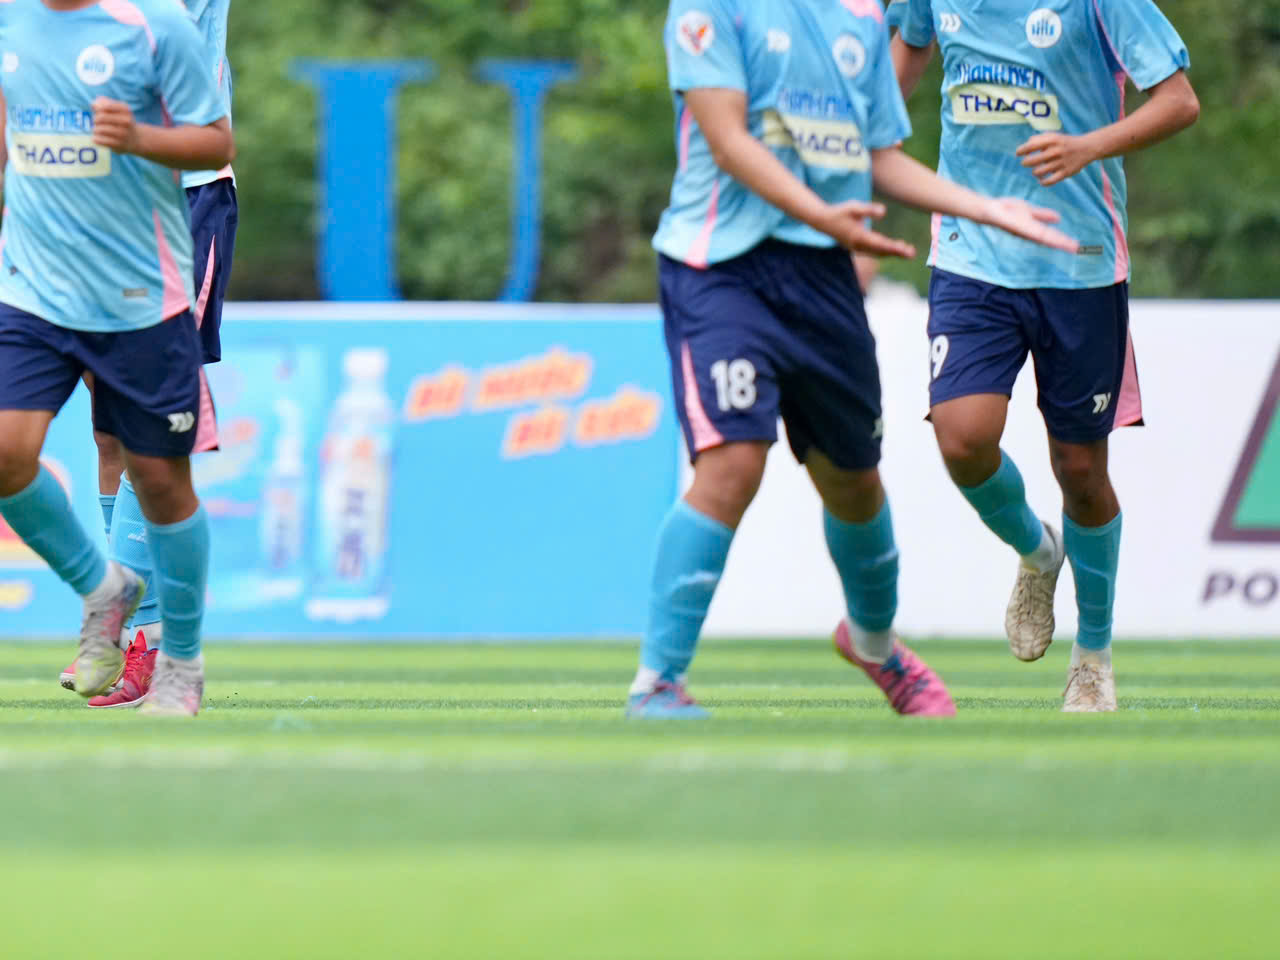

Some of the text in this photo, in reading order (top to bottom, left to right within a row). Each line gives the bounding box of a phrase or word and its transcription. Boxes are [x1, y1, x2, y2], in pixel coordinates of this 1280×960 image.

[959, 94, 1052, 118] THACO
[794, 132, 863, 157] HACO
[710, 358, 758, 411] 18
